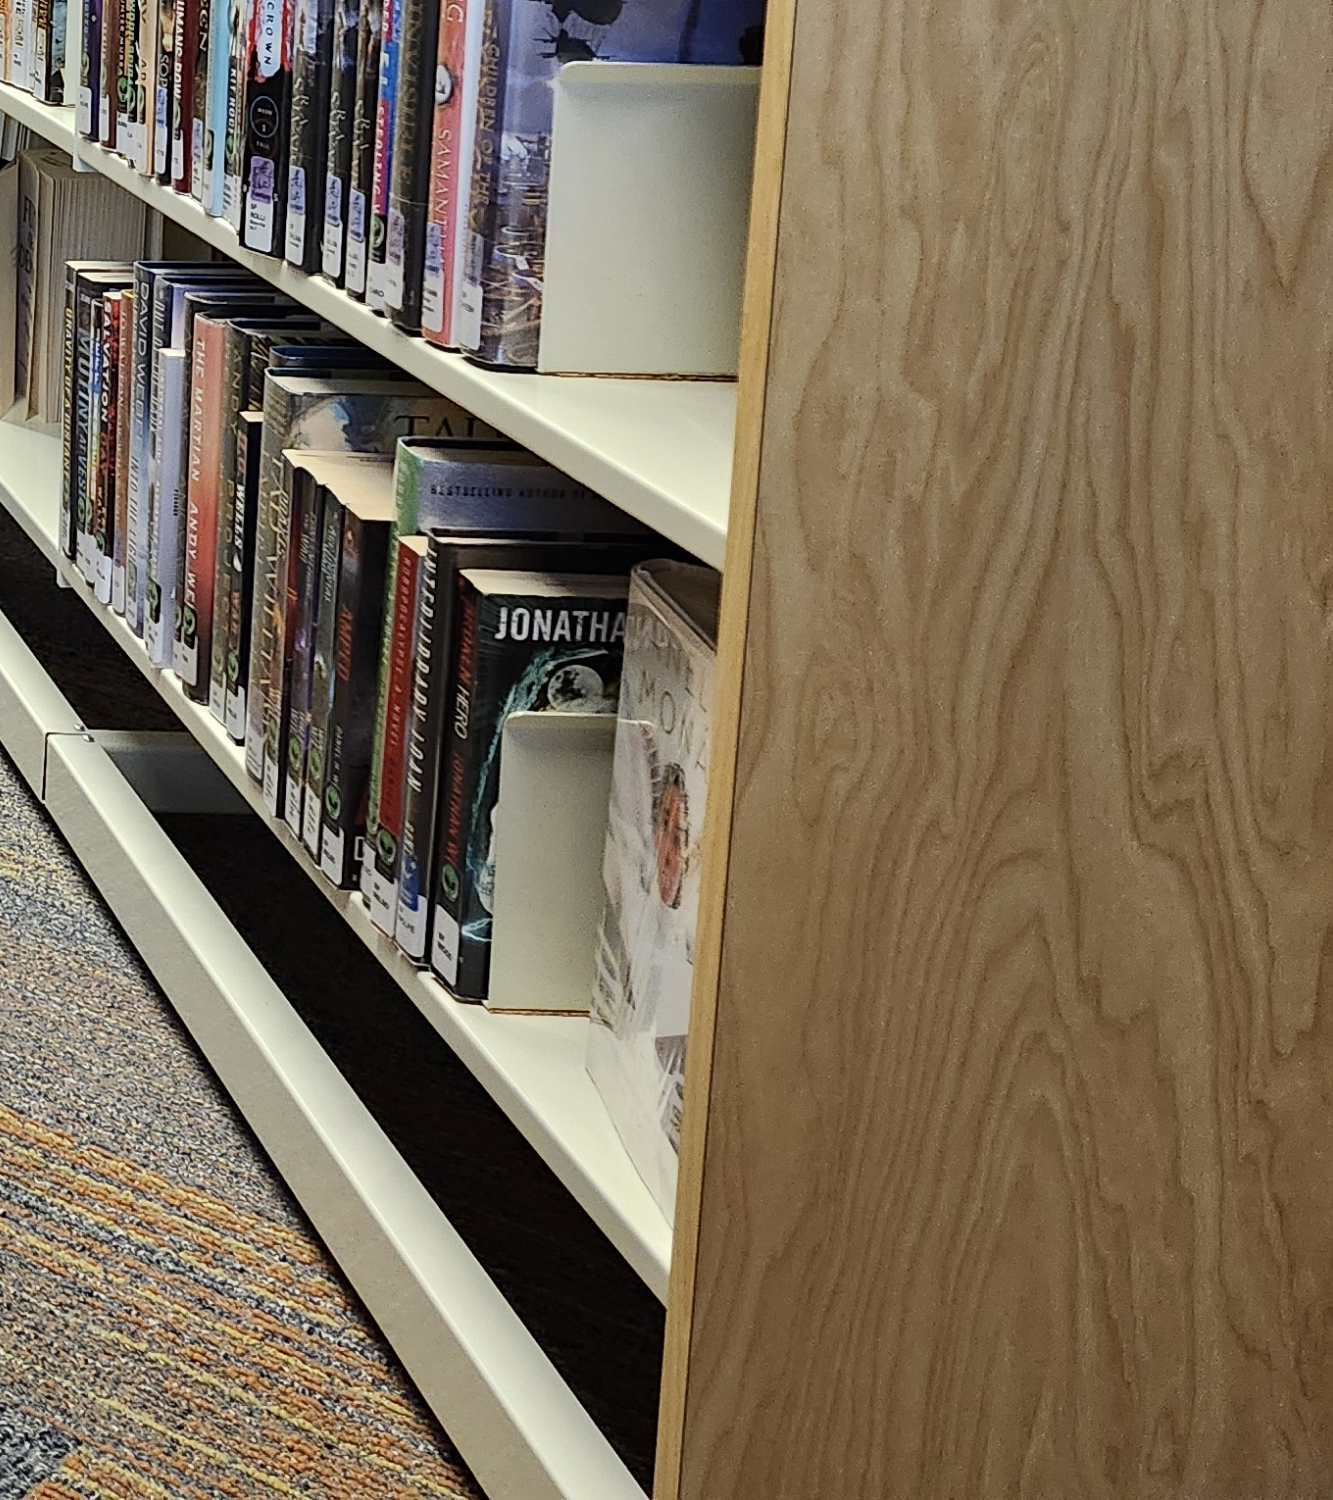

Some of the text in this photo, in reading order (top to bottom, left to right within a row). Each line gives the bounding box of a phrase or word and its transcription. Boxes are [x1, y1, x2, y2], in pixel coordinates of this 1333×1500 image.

[263, 1, 276, 65] CROWN
[486, 44, 502, 132] CHILDREN
[481, 171, 492, 205] THE
[64, 307, 73, 370] GRAVITY
[138, 281, 150, 356] DAVID
[76, 327, 91, 432] MUTINY
[101, 301, 112, 422] SALVATION
[77, 453, 88, 498] VEST
[130, 456, 139, 493] INTO
[185, 337, 206, 610] THE MARTIAN ANDY WEI
[233, 484, 246, 552] WELLS
[338, 604, 355, 681] AMPED
[493, 606, 628, 643] JONATHA
[406, 545, 438, 793] INTERLIBRARY LOAN
[454, 683, 472, 740] HERO
